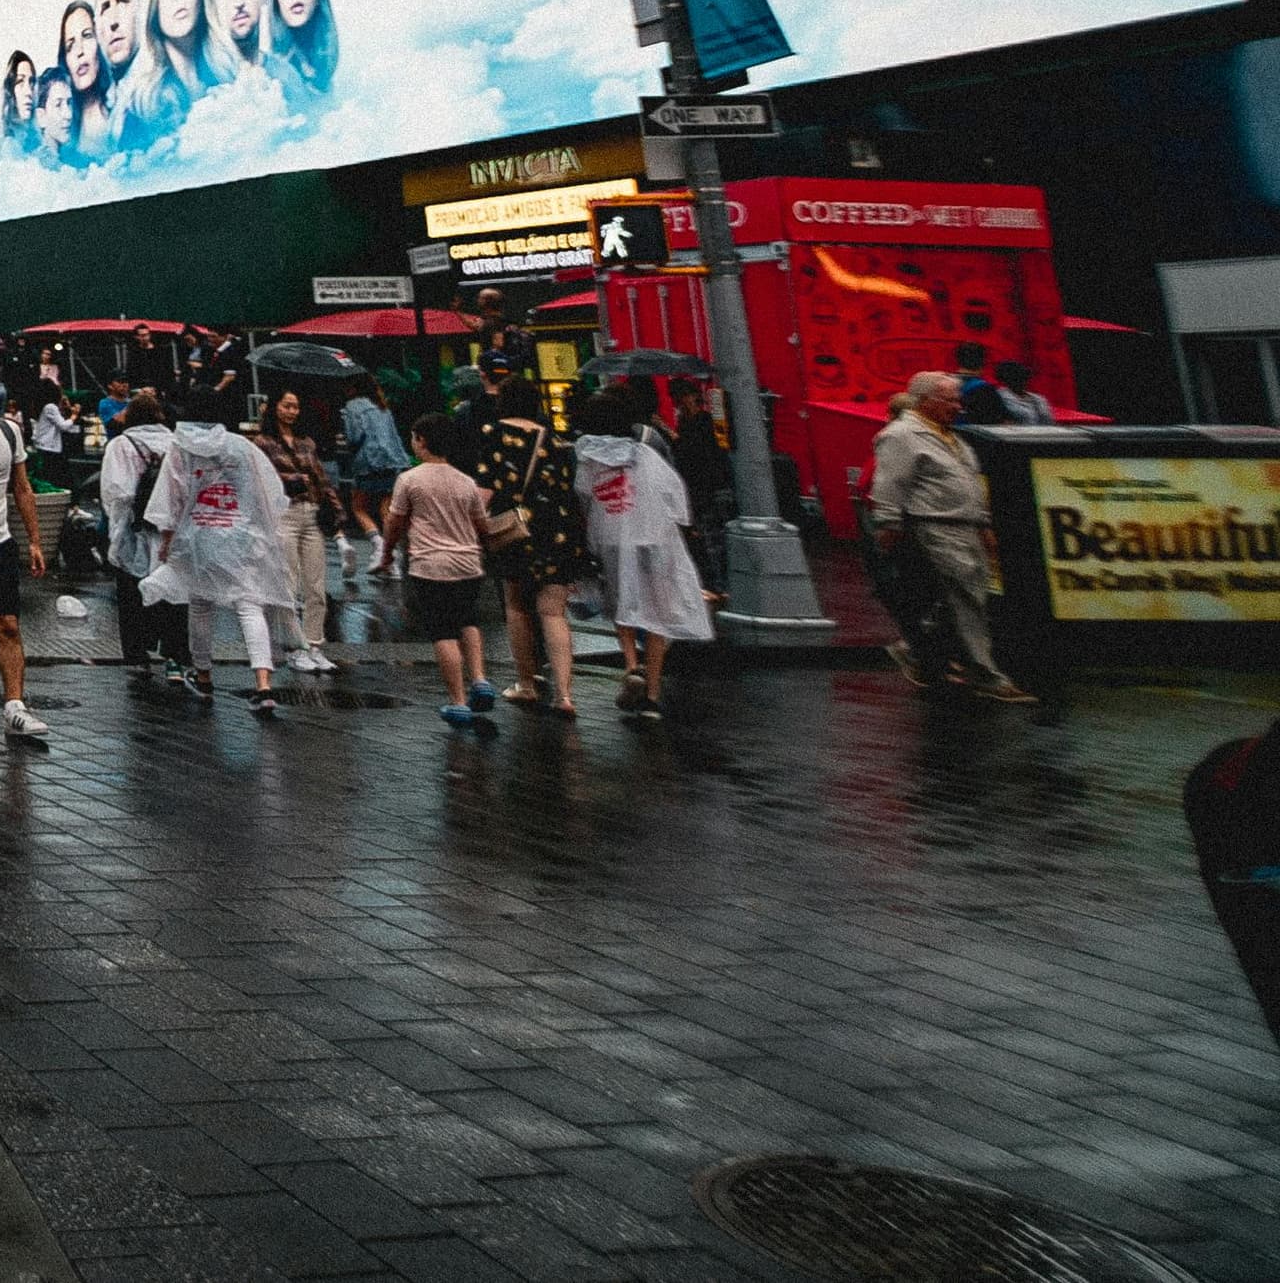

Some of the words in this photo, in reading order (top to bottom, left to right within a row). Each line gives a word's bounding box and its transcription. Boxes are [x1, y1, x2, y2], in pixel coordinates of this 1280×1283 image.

[661, 106, 697, 125] ONE
[714, 105, 755, 124] WAY
[469, 146, 583, 188] INVICTA
[792, 201, 914, 227] COFFEED
